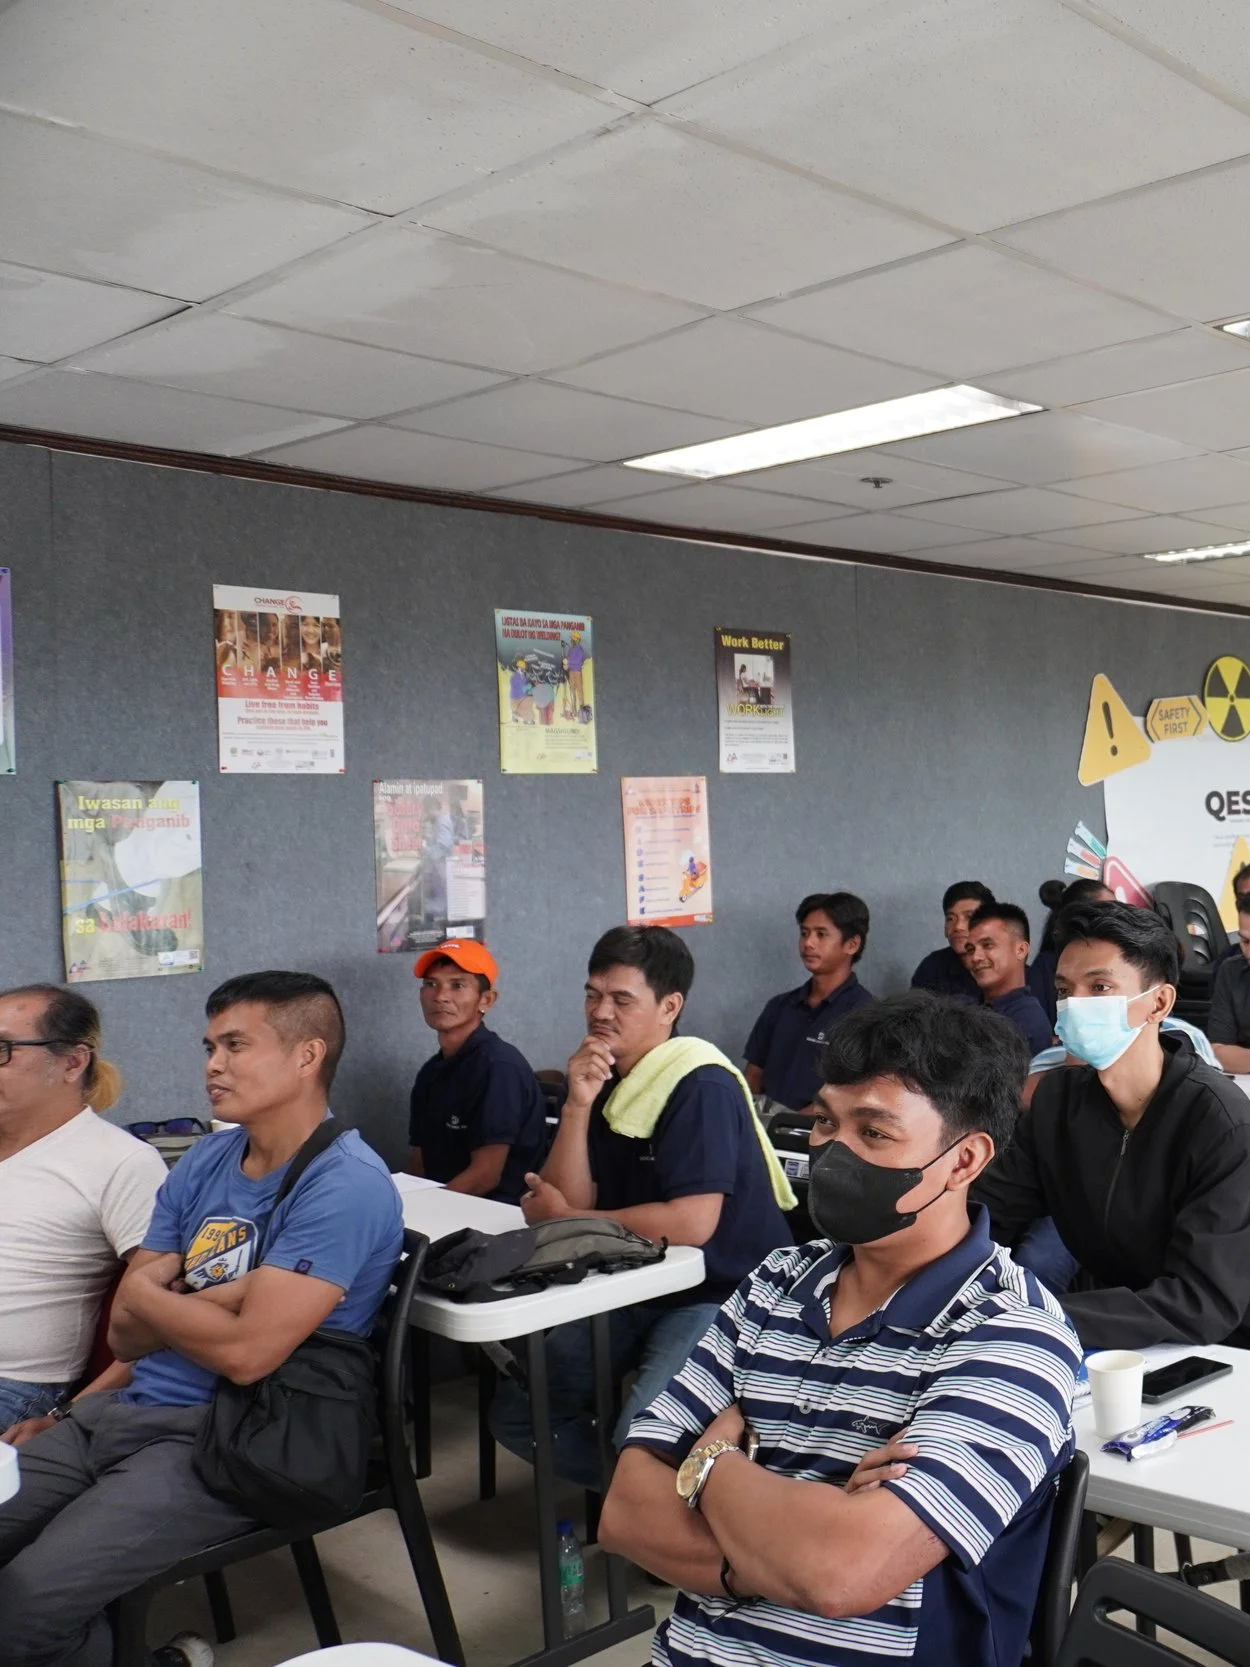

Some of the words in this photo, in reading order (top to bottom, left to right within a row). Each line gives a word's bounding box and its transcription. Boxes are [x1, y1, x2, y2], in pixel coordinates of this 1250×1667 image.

[254, 597, 285, 605] CHANGE
[721, 634, 749, 648] Work
[751, 637, 784, 650] Better
[245, 700, 260, 708] Live
[297, 702, 319, 710] habits
[726, 704, 760, 717] WORK
[1158, 707, 1190, 721] SAFETY
[1164, 722, 1188, 735] FIRST
[78, 796, 142, 810] Iwasan
[147, 799, 180, 812] ang
[67, 818, 105, 833] mga
[111, 815, 190, 831] Panganib
[76, 918, 96, 934] sa
